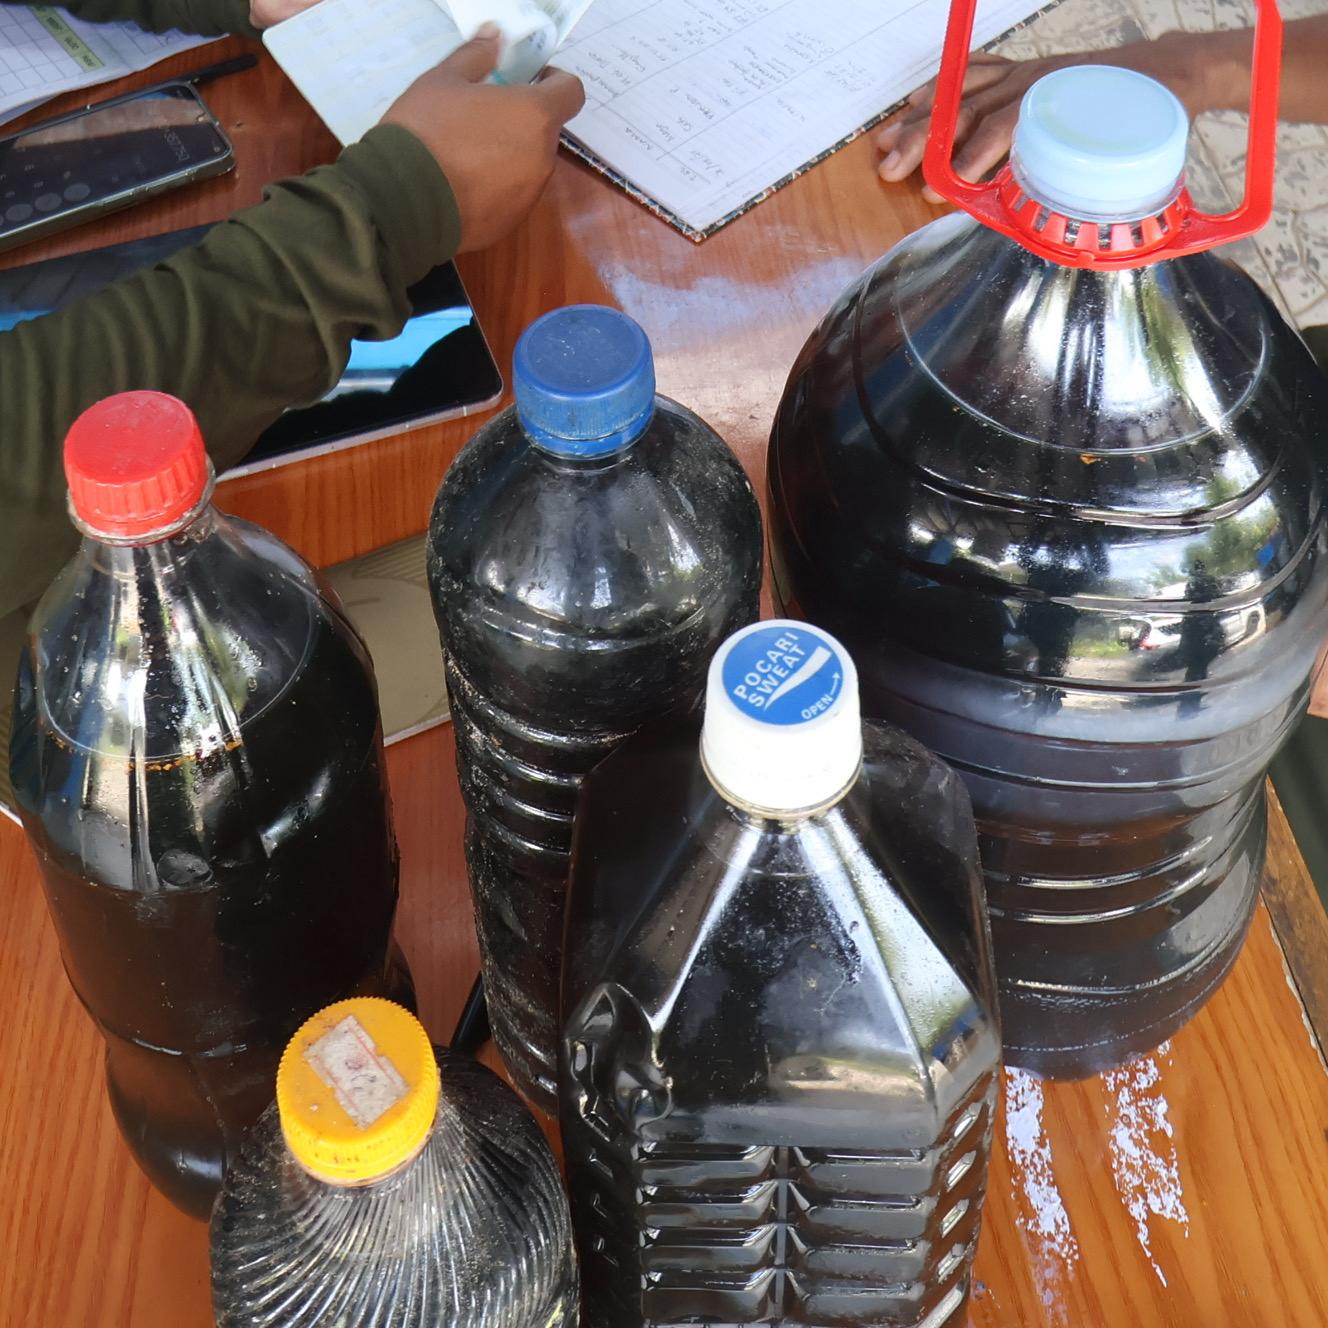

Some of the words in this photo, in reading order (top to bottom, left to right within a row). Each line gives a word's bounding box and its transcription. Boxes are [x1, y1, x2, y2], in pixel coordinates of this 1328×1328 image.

[733, 631, 799, 700] POCARI
[748, 644, 806, 708] SWEAT
[801, 695, 833, 720] OPEN
